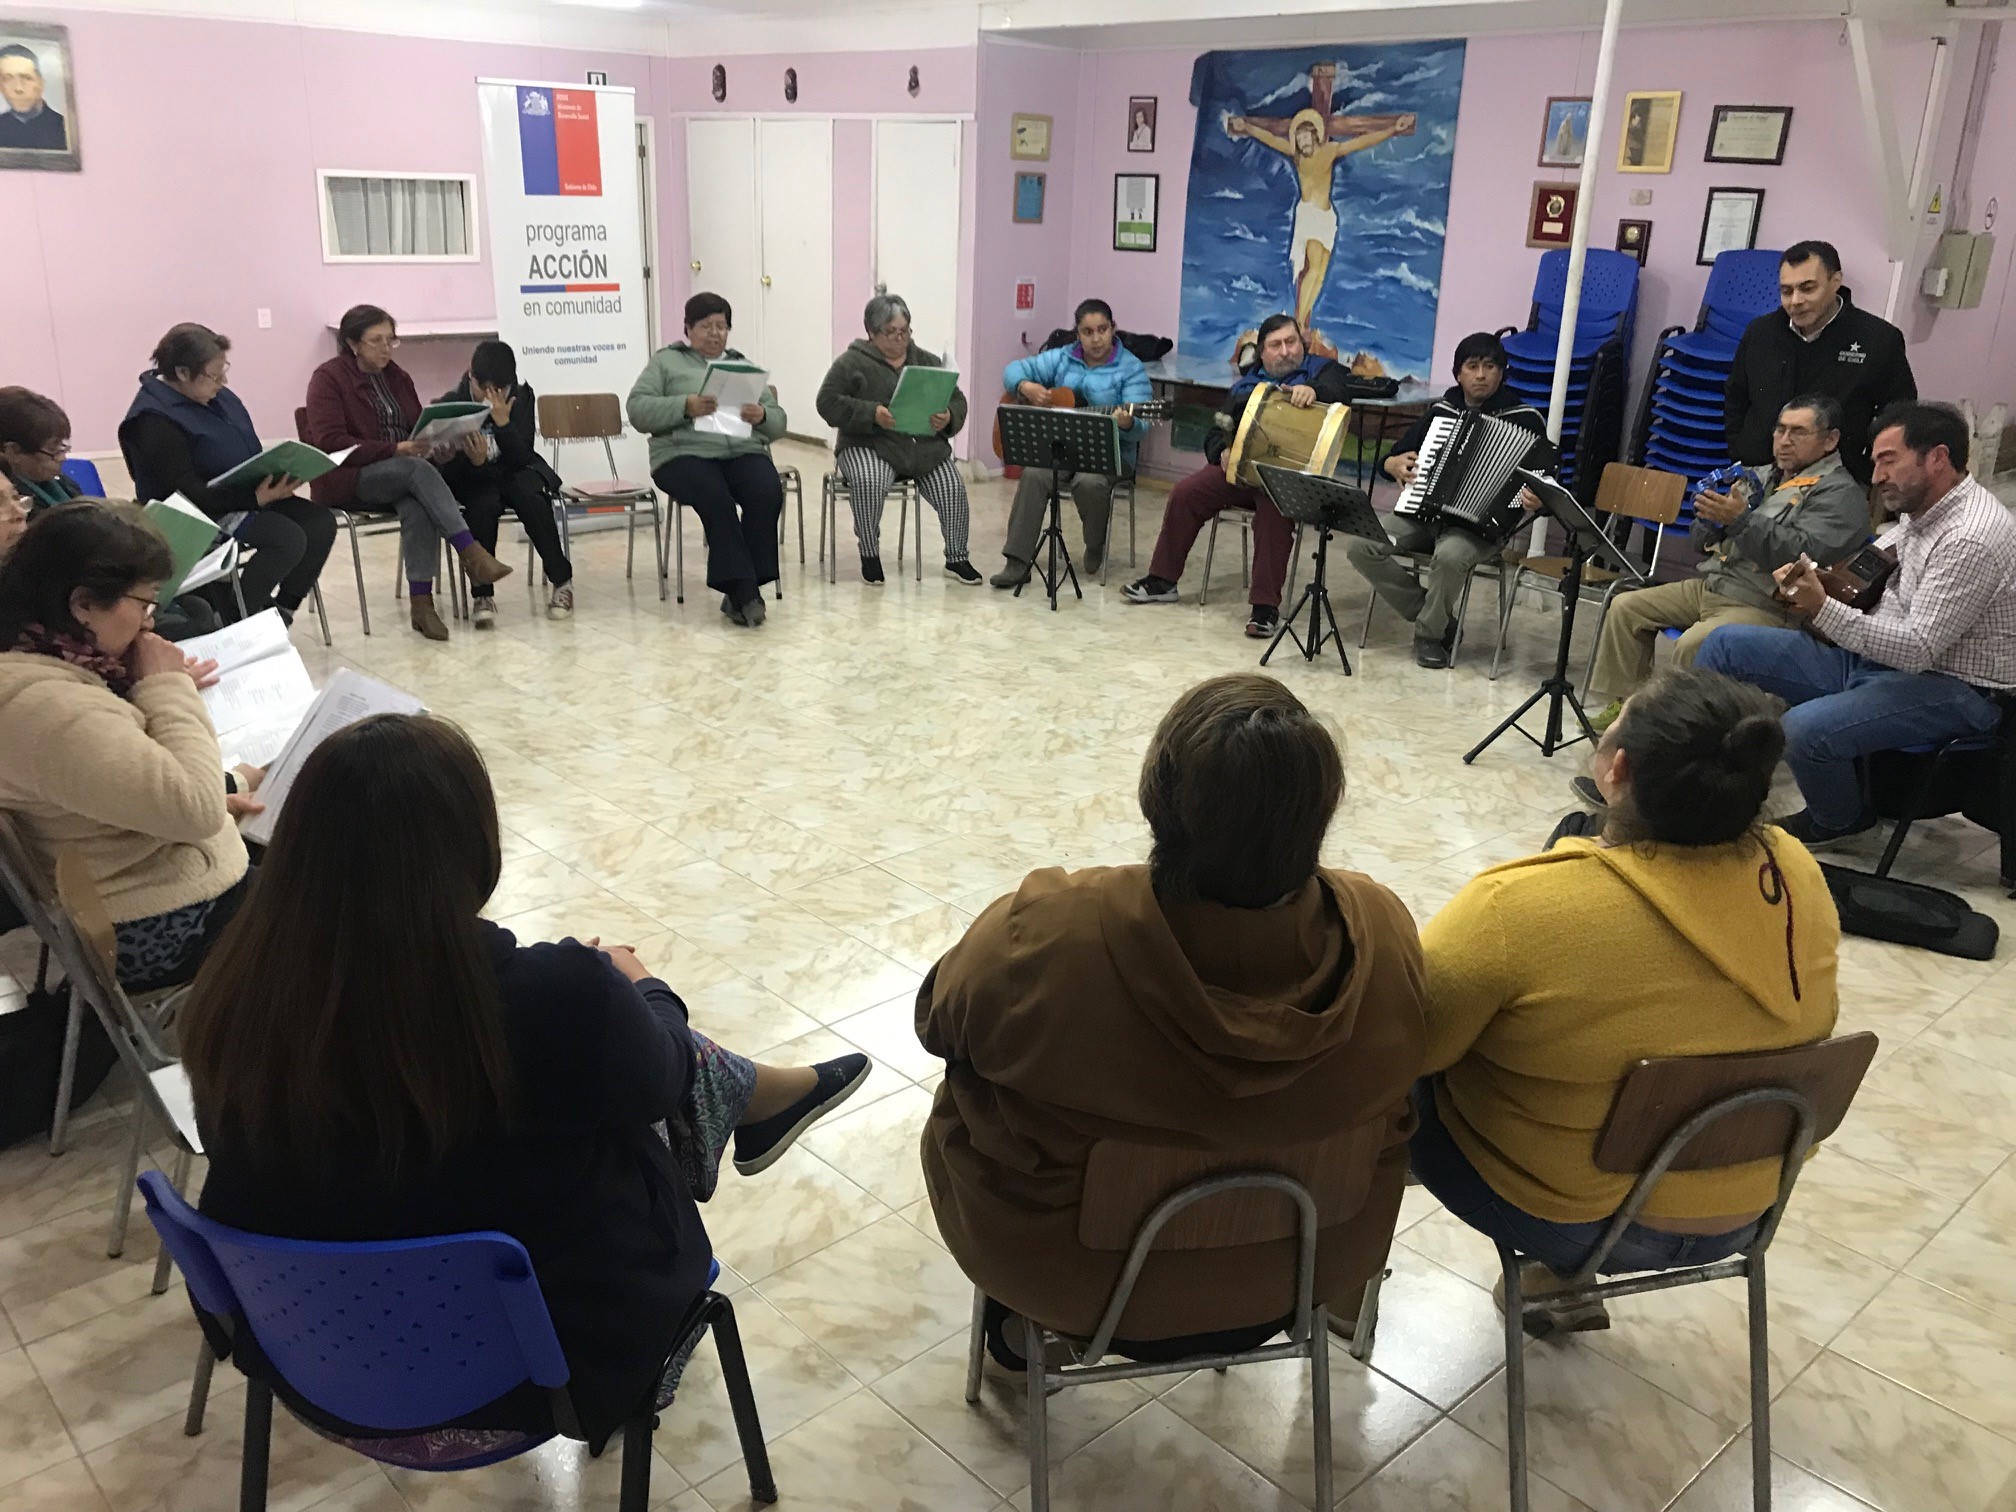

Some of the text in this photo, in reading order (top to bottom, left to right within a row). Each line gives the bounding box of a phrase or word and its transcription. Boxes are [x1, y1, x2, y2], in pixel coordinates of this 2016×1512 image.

[525, 224, 608, 247] programa
[529, 249, 607, 279] ACCIÓN
[523, 295, 622, 317] en comunidad
[521, 342, 627, 355] Uniendo nuestras voces en
[554, 355, 598, 366] comunidad
